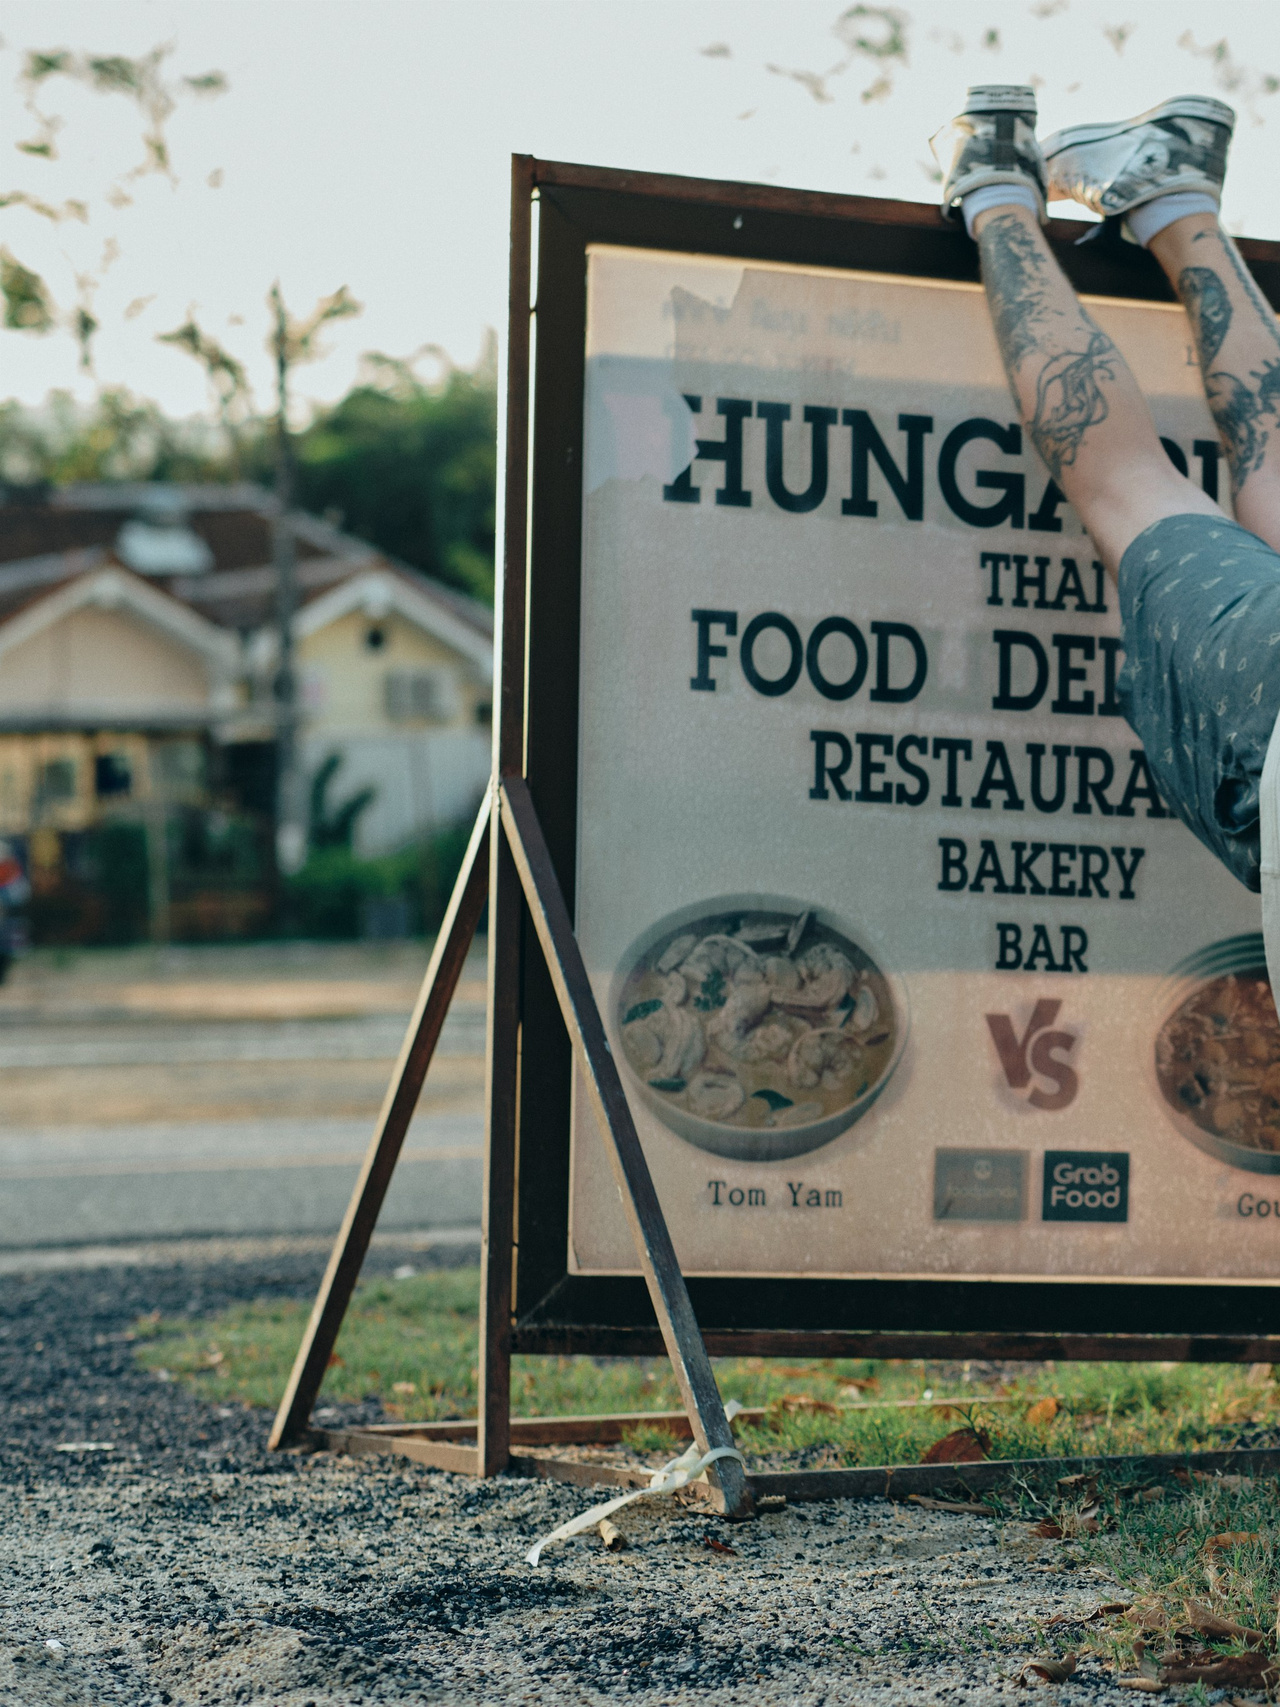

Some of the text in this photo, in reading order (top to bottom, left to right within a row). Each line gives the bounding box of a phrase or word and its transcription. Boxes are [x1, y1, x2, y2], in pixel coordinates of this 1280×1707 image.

[690, 608, 927, 703] FOOD
[808, 731, 1178, 819] RESTAURA
[937, 838, 1145, 900] BAKERY
[995, 923, 1089, 972] BAR
[985, 998, 1078, 1111] VS
[708, 1180, 843, 1207] Tom Yam
[1051, 1186, 1120, 1208] Food
[1053, 1163, 1119, 1185] Grab
